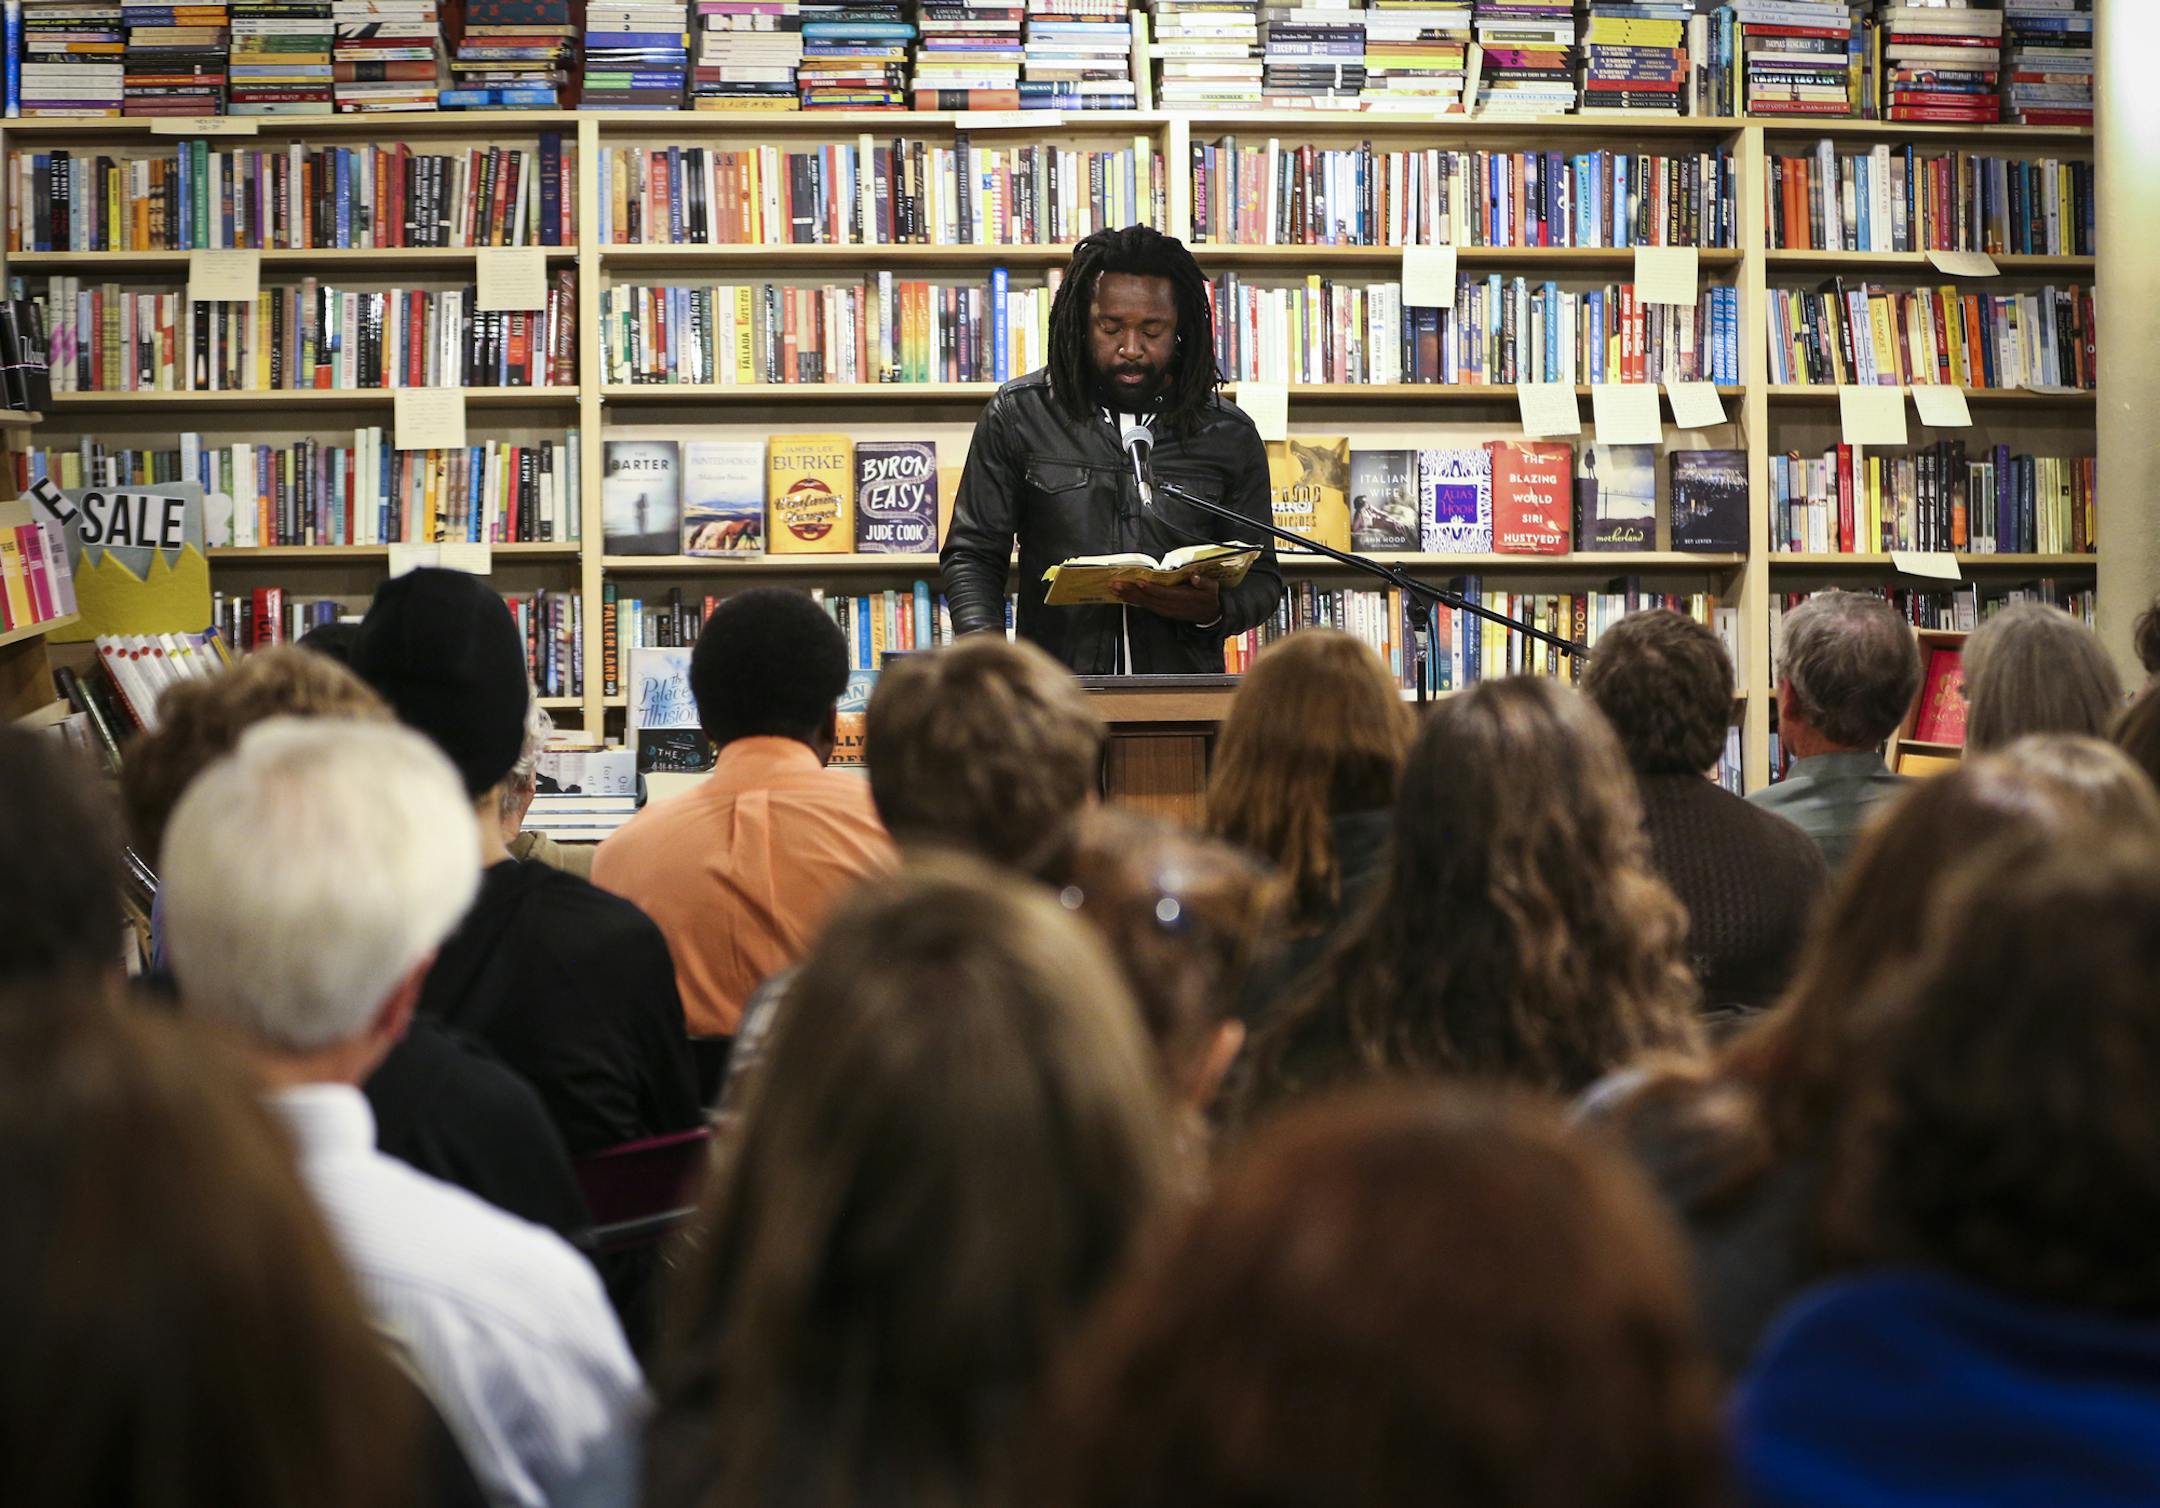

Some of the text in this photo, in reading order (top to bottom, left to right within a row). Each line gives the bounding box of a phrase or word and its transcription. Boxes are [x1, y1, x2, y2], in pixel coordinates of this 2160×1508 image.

[560, 311, 573, 356] Abraham
[1714, 288, 1724, 379] THE OLD NEIGHBORHOOD
[1726, 288, 1736, 380] THE OLD NEIGHBORHOOD
[742, 332, 750, 369] FALLADA
[521, 455, 529, 482] ALEPH
[612, 459, 669, 470] BARTER
[773, 454, 845, 470] BURKE
[1523, 454, 1544, 464] THE
[862, 456, 931, 482] BYRON
[1360, 474, 1408, 484] ITALIAN
[1509, 474, 1557, 484] BLAZING
[870, 484, 926, 512] EASY
[1369, 488, 1399, 498] WIFE
[1443, 488, 1472, 500] ALIAS
[1513, 494, 1553, 504] WORLD
[80, 492, 185, 548] SALE
[1522, 514, 1542, 523] SIRI
[866, 524, 924, 540] JUDE COOK
[1504, 534, 1561, 545] HUSTVEDT
[1596, 527, 1644, 543] motherland
[1575, 598, 1586, 638] WOOL
[604, 603, 616, 681] FALLEN LAND
[642, 676, 690, 704] Palace
[639, 705, 700, 728] Illusion
